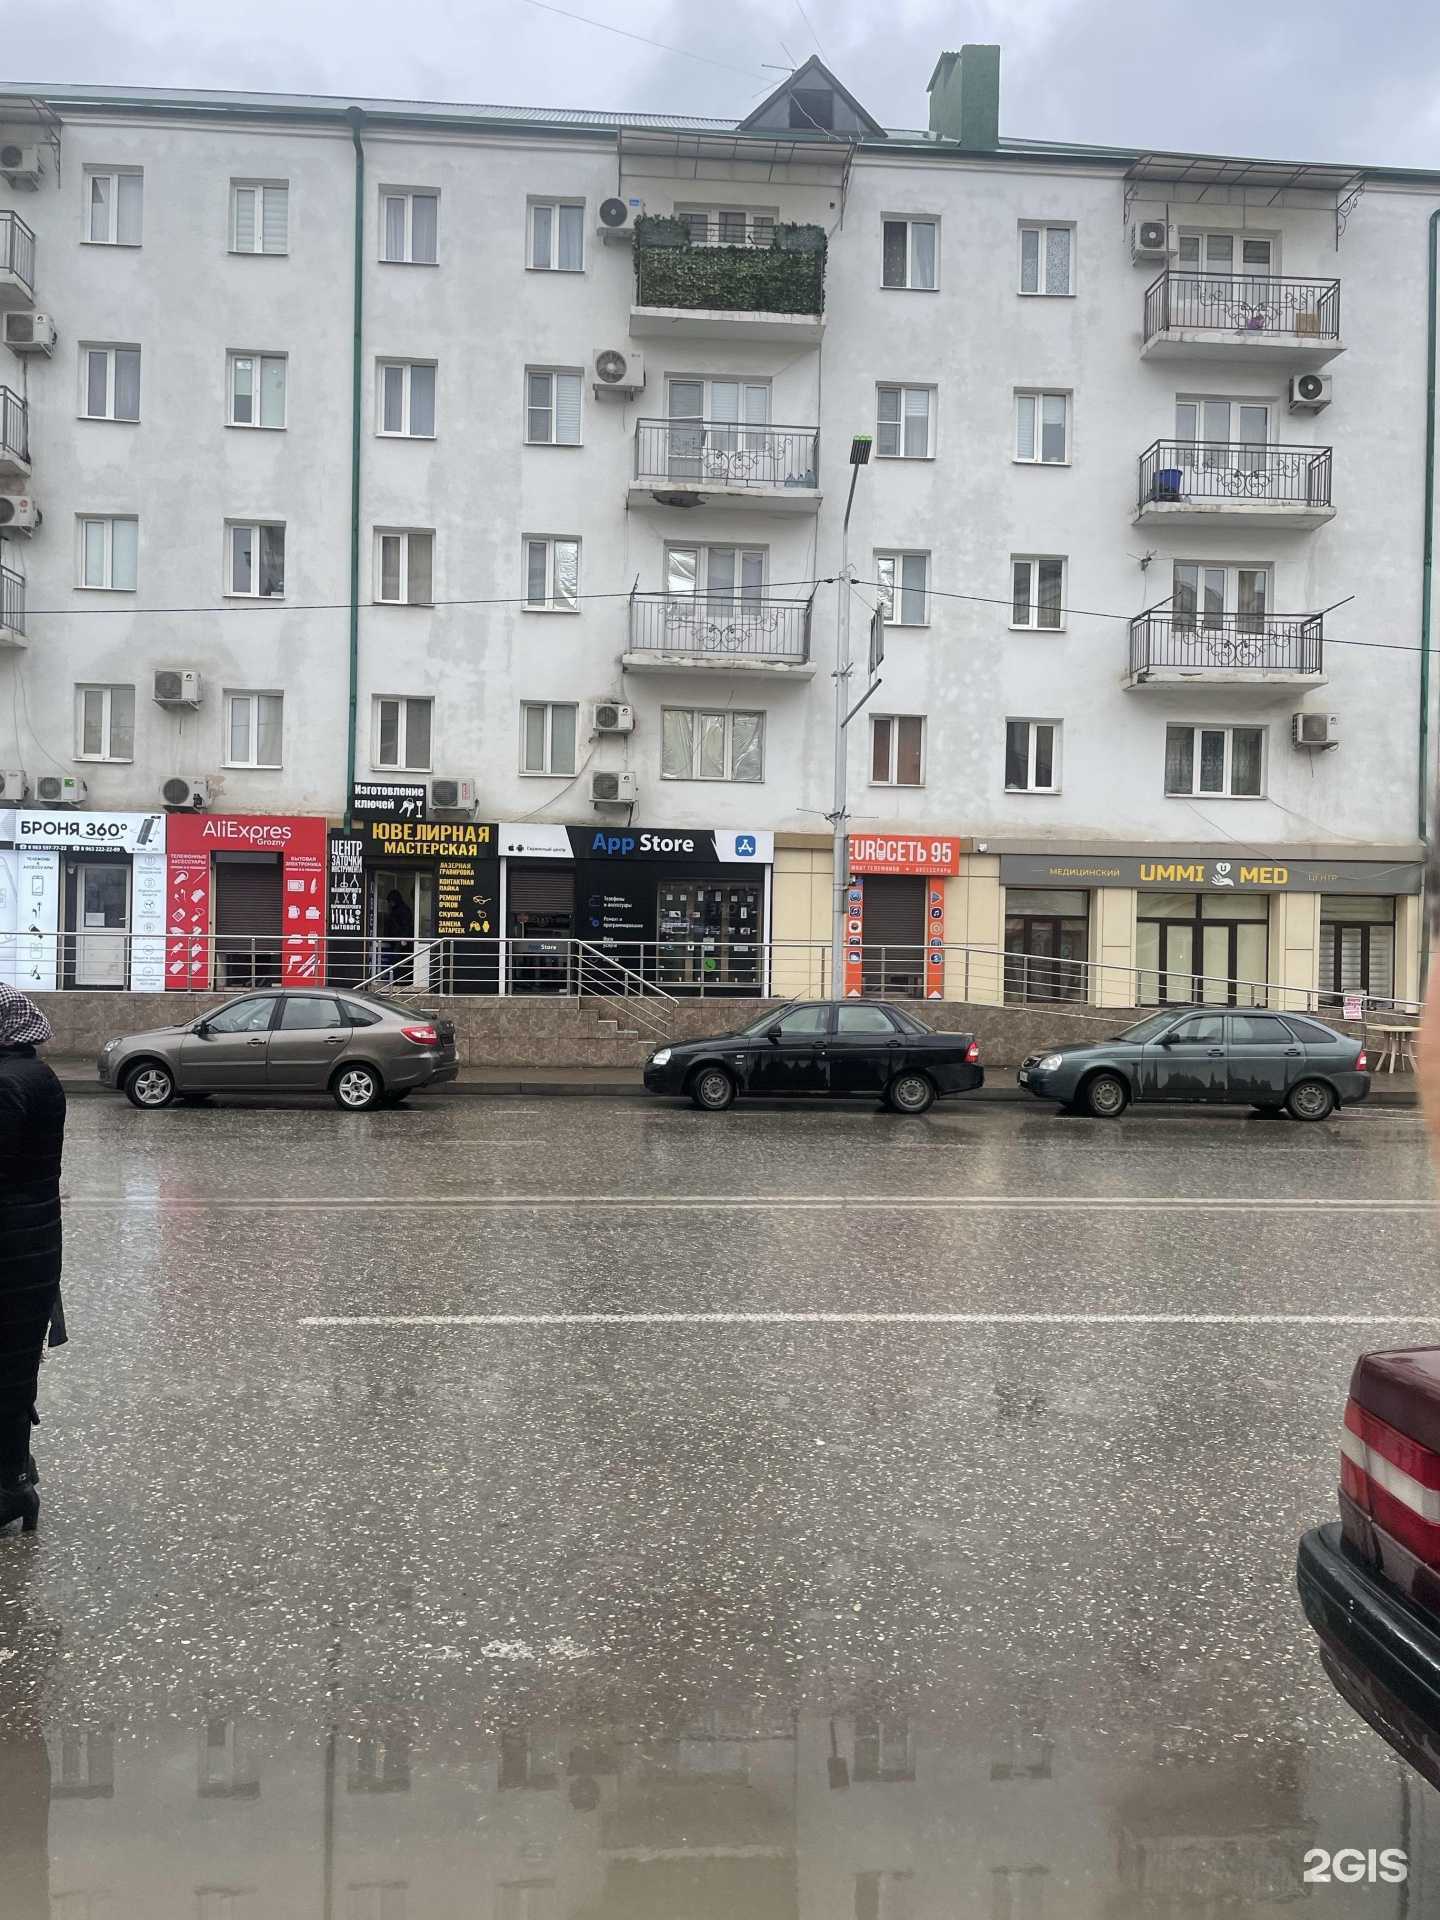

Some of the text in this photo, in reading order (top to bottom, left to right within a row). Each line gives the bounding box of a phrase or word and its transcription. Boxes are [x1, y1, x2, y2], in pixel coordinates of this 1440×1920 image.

[354, 784, 424, 797] Изготовление
[354, 798, 395, 810] ключей
[21, 821, 127, 837] БРОНЯ 360°
[202, 820, 292, 843] AliExpres
[372, 822, 490, 843] ЮВЕЛИРНАЯ
[257, 838, 286, 847] Grozny
[331, 840, 363, 856] ЦЕНТР
[384, 841, 478, 856] МАСТЕРСКАЯ
[592, 832, 695, 855] App Store
[931, 842, 952, 863] 95
[331, 855, 363, 866] ЗАТОЧКИ
[439, 868, 475, 876] ГРАВИРОВКА
[1049, 867, 1120, 878] МЕДИЦИНСКИЙ
[1139, 863, 1288, 884] UMMI MED
[439, 894, 462, 902] РЕМОНТ
[439, 901, 459, 909] ОЧКОВ
